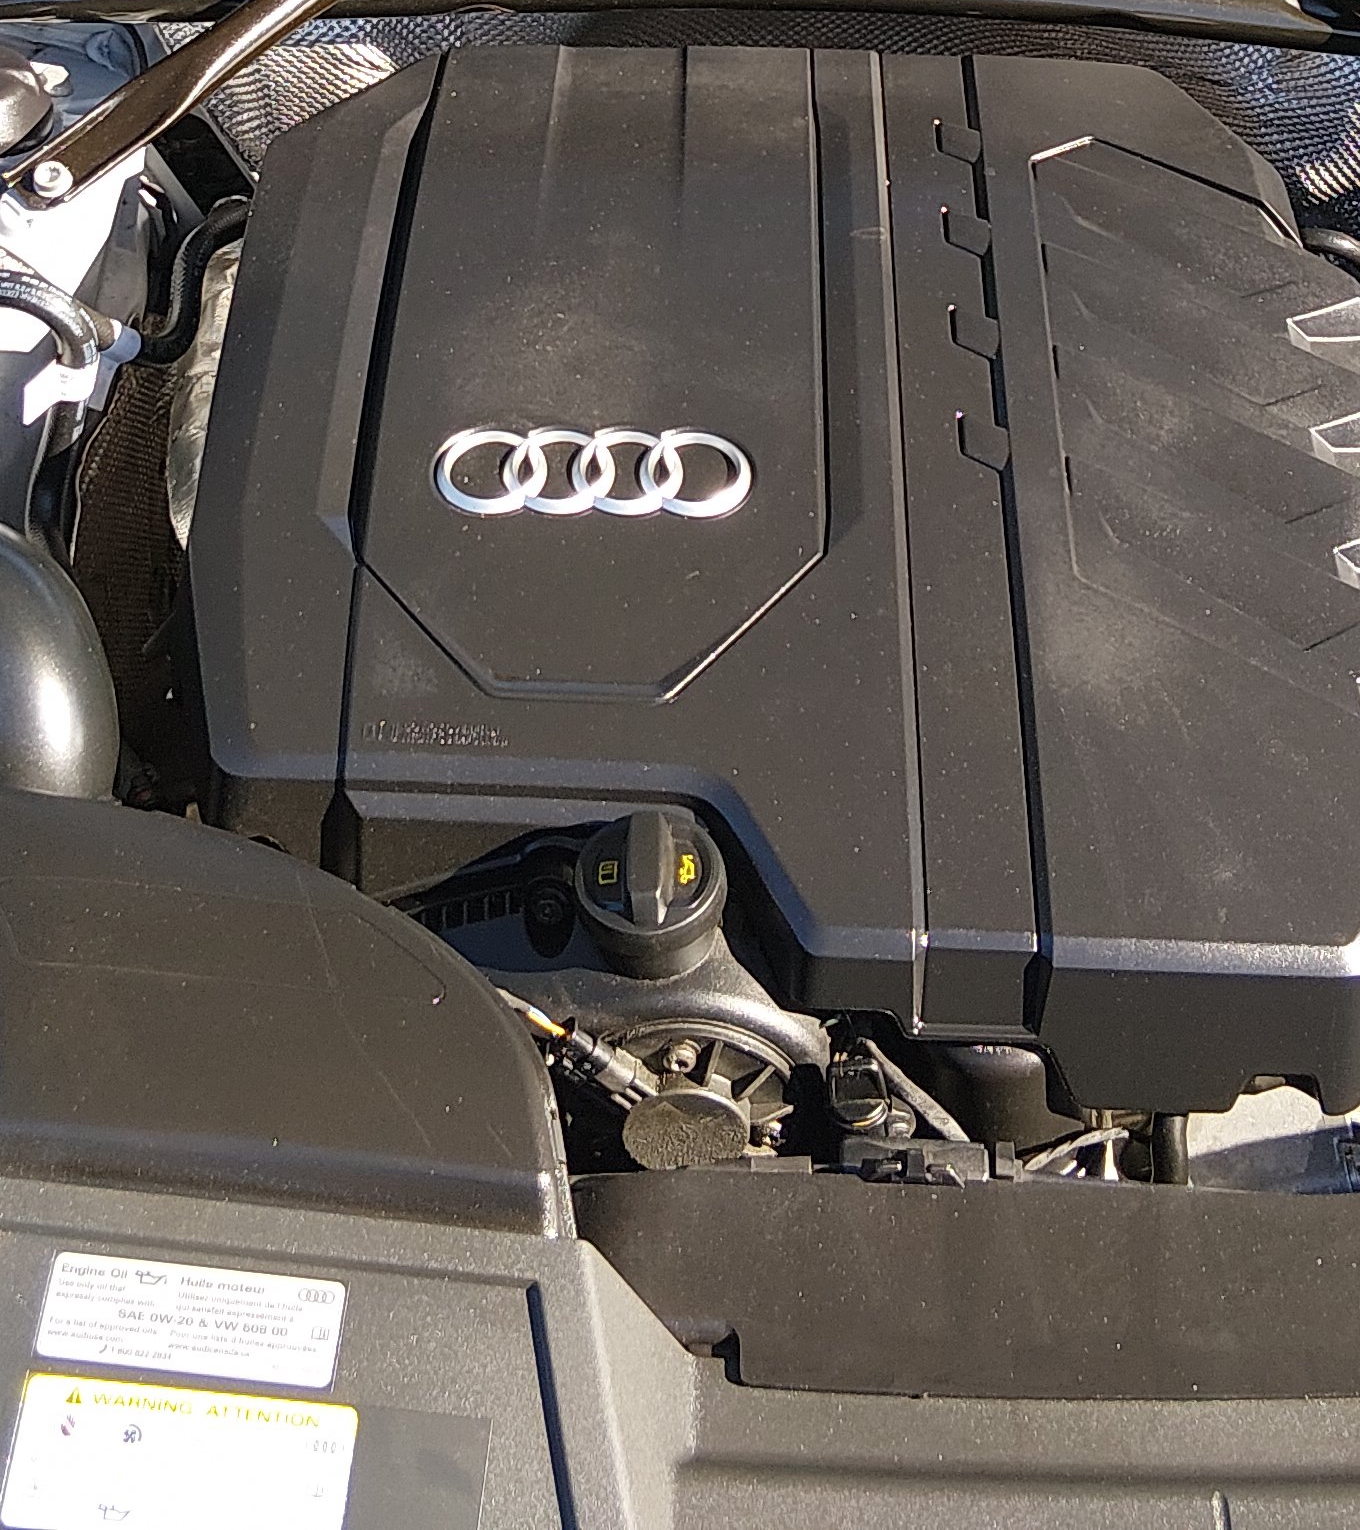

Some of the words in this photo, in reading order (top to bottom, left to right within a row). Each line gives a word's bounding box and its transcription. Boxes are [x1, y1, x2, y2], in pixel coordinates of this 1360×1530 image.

[62, 1262, 105, 1276] Engine
[110, 1268, 128, 1278] Oil
[58, 1278, 74, 1286] Use
[77, 1280, 94, 1290] only
[110, 1284, 126, 1292] that
[180, 1276, 213, 1288] Huile
[218, 1282, 265, 1294] moteur
[118, 1308, 144, 1320] SAE
[150, 1312, 194, 1327] 0W-20
[198, 1318, 208, 1328] &
[214, 1320, 239, 1332] VW
[94, 1393, 192, 1414] WARNING
[206, 1405, 318, 1428] ATTENTION
